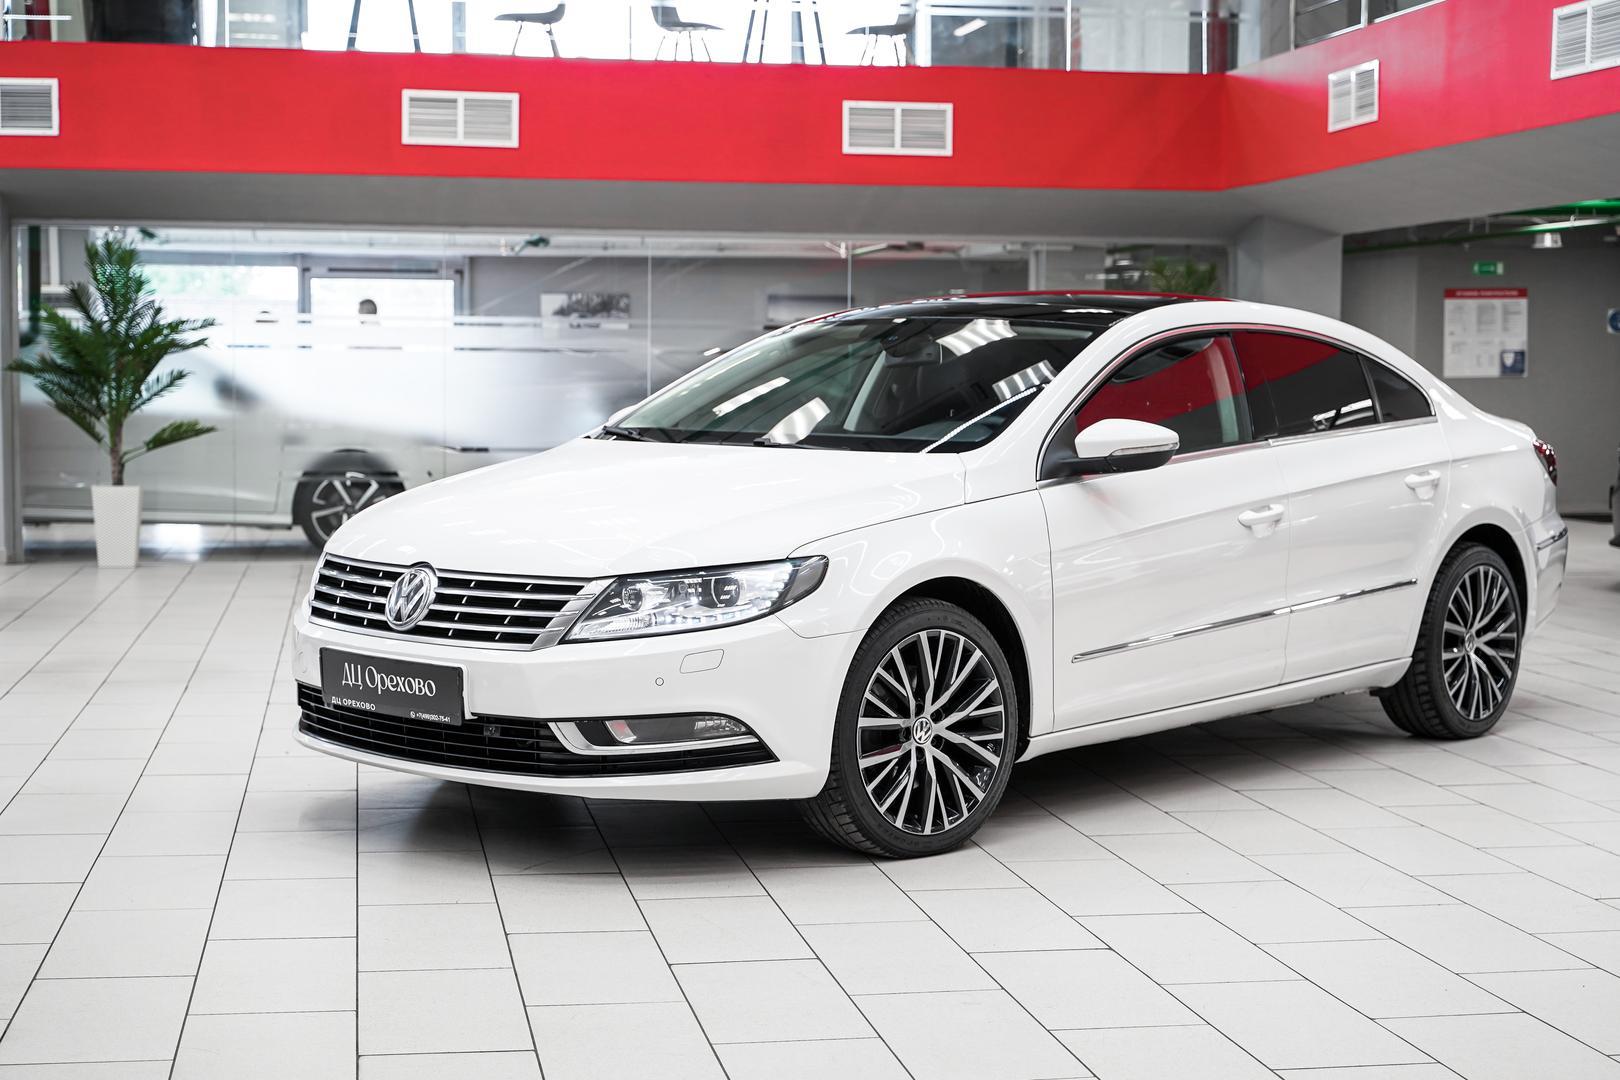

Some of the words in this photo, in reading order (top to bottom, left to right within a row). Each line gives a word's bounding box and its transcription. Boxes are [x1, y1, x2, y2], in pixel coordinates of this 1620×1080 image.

[386, 569, 430, 629] VW
[342, 662, 363, 690] ДЦ
[365, 665, 436, 697] Орехово
[331, 696, 342, 706] ДЦ
[342, 698, 376, 711] ОРЕХОВО
